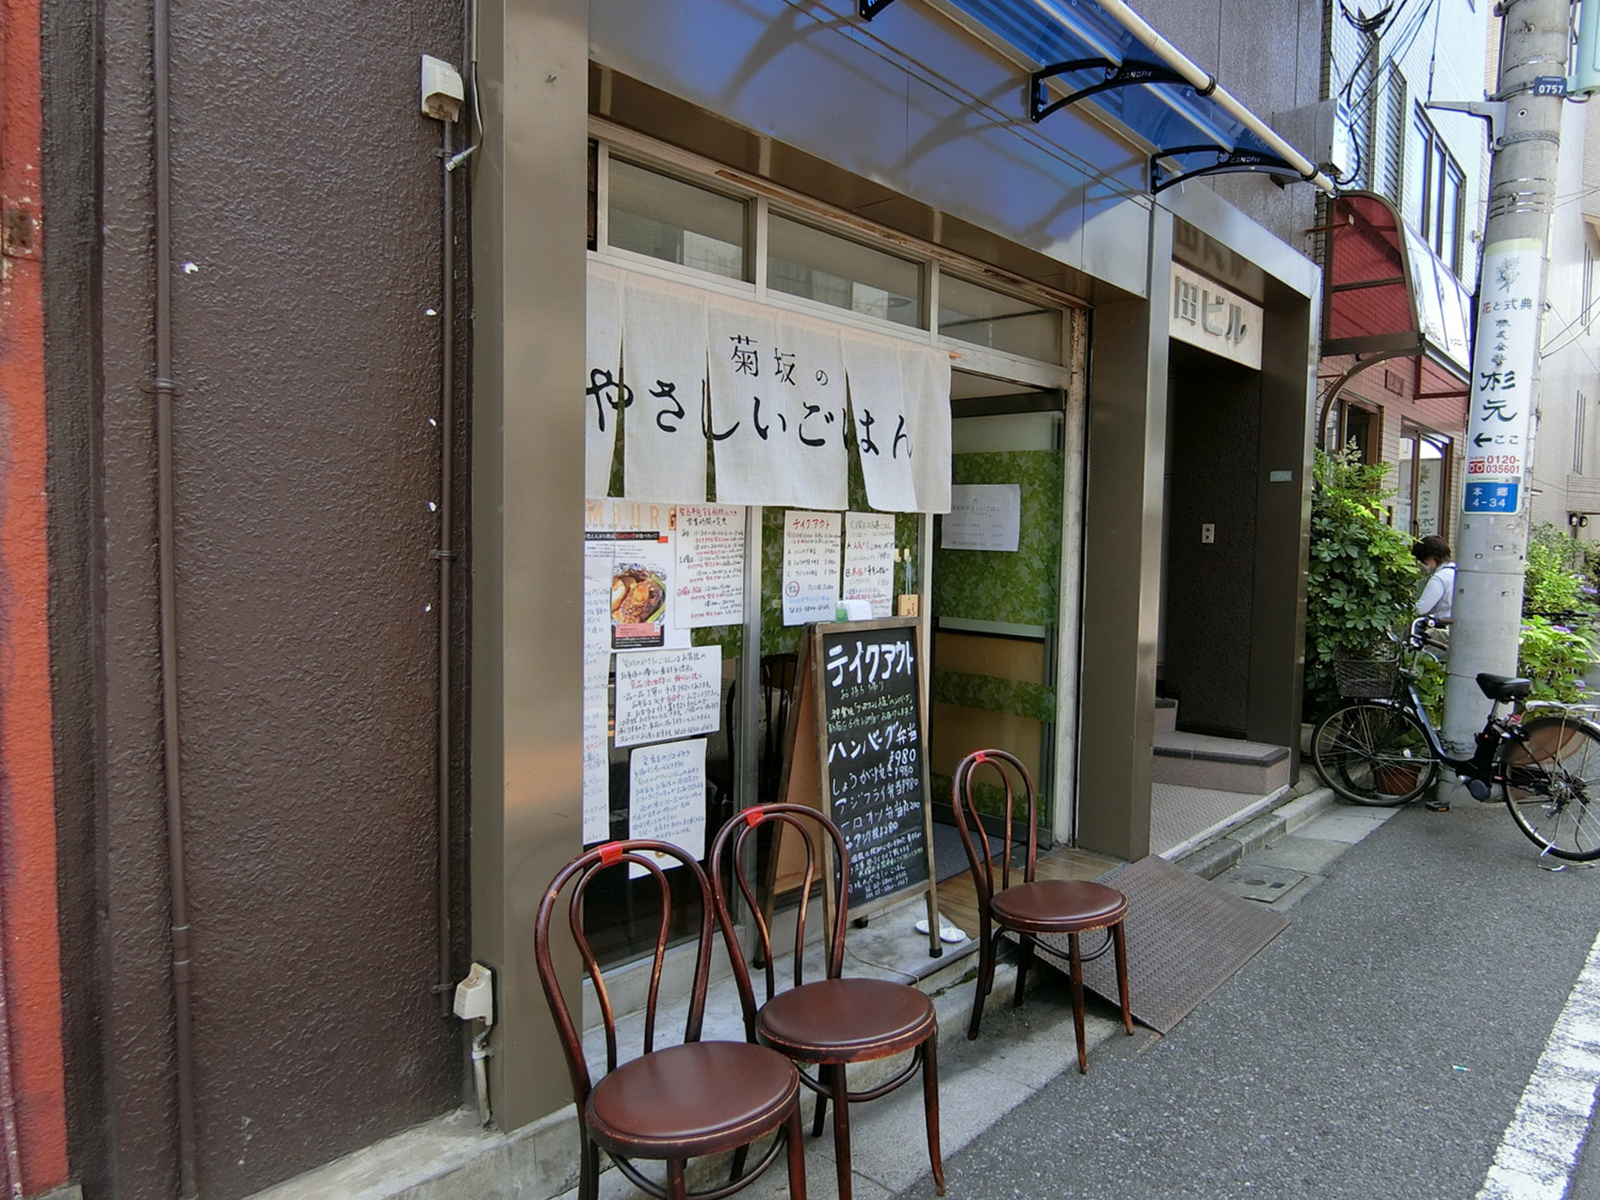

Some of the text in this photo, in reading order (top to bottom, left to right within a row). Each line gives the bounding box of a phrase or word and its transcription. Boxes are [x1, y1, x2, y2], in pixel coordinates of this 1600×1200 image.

[1538, 84, 1564, 94] 0757
[1482, 297, 1532, 315] 花と式典
[730, 334, 830, 386] 菊坂の
[1480, 370, 1517, 422] 杉元
[586, 368, 914, 460] やさしいごはん
[1494, 435, 1519, 445] ここ
[1487, 455, 1520, 464] 0120-
[1486, 465, 1519, 474] 035601
[1472, 498, 1506, 507] 4-34
[793, 519, 830, 530] テイクアウト
[826, 640, 914, 688] テイクアウト
[828, 721, 918, 764] ハンバーグ弁当
